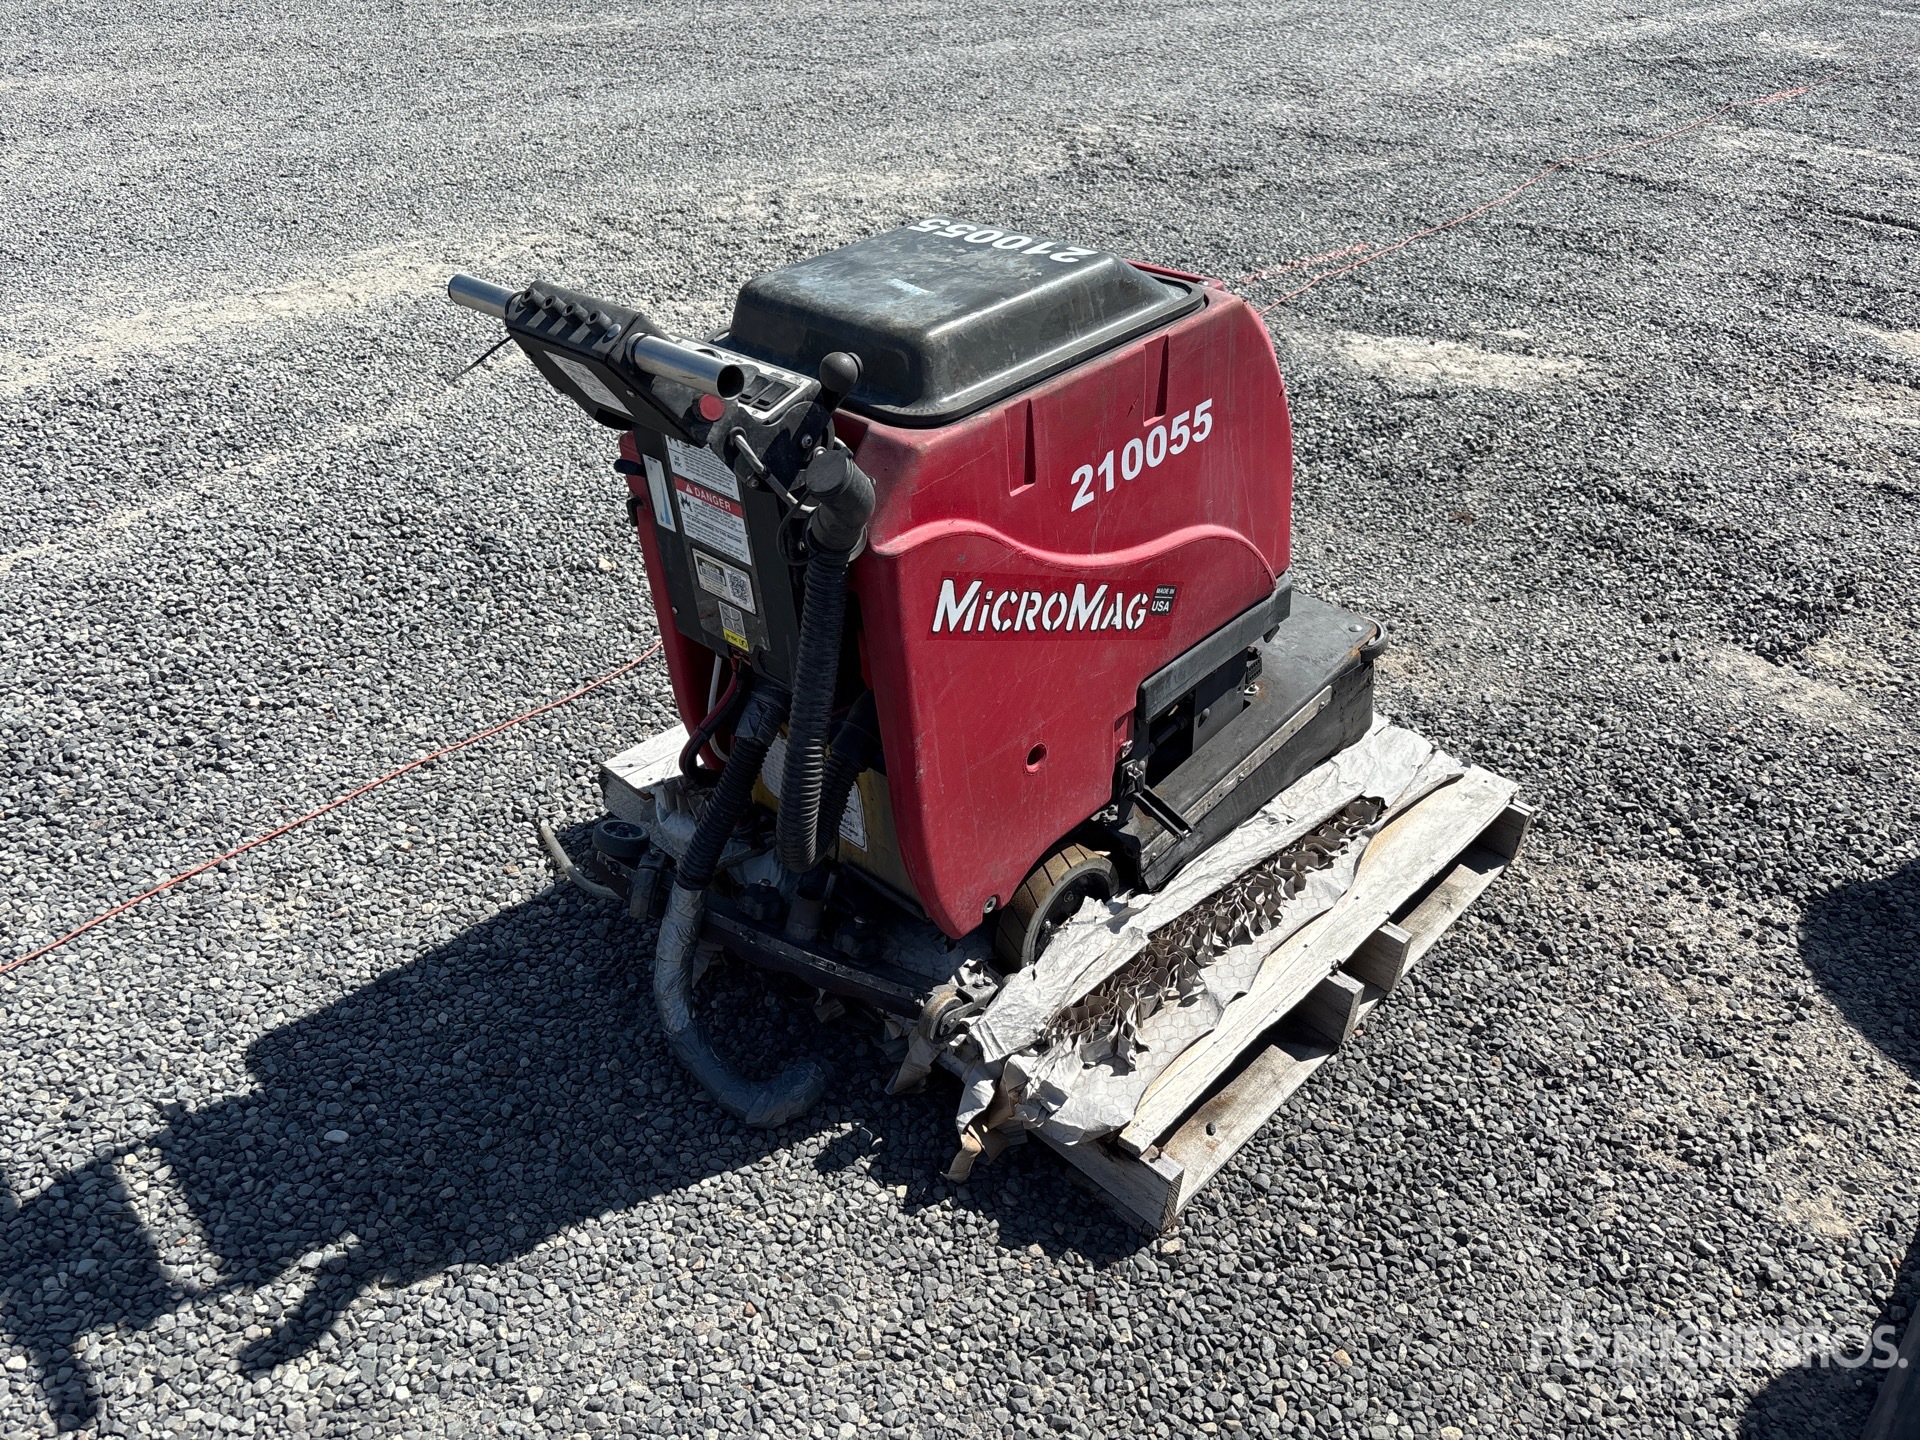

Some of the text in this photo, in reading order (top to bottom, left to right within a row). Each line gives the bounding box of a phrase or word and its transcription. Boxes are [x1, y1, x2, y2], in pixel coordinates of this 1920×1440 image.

[907, 218, 1099, 263] 210055
[1071, 398, 1213, 512] 210055
[694, 487, 732, 512] DANGER
[1151, 601, 1169, 612] USA
